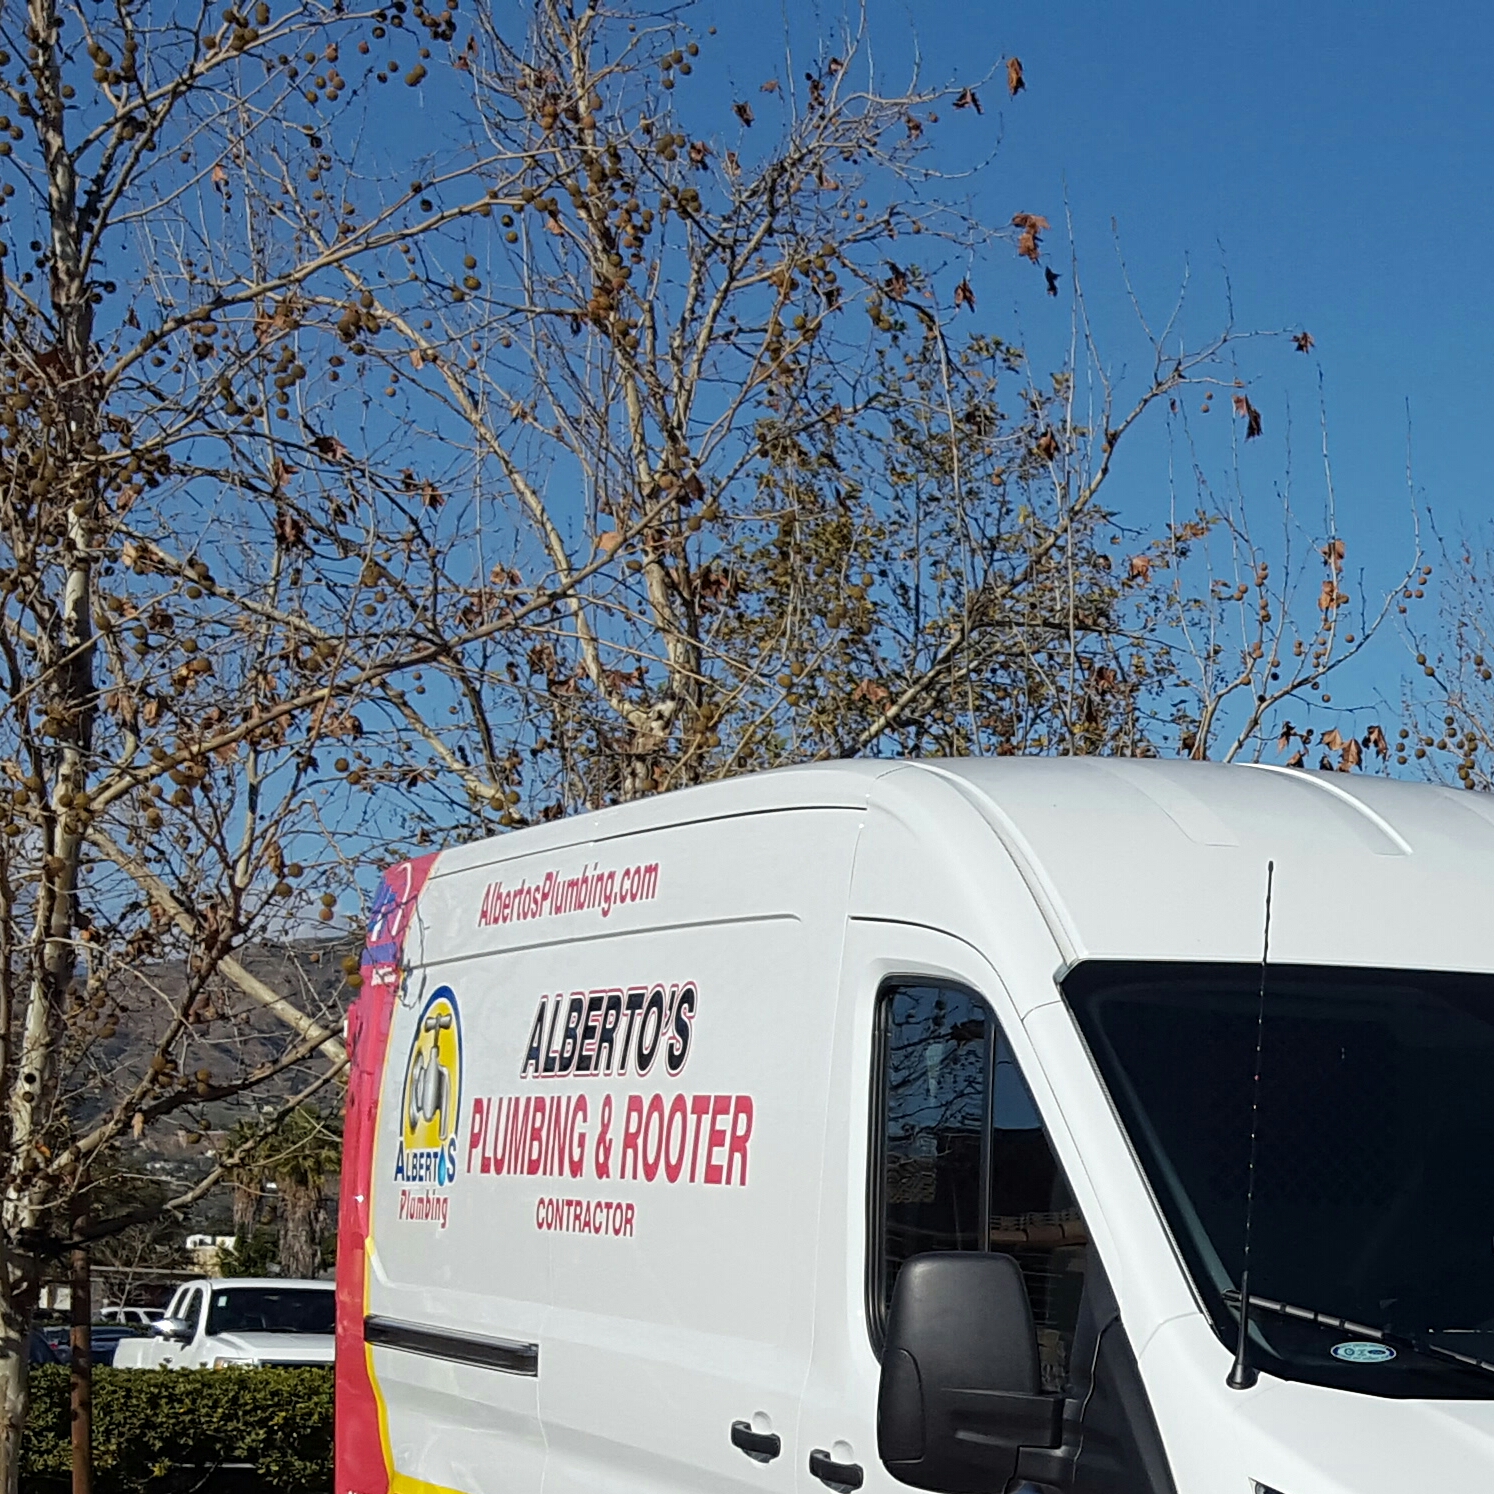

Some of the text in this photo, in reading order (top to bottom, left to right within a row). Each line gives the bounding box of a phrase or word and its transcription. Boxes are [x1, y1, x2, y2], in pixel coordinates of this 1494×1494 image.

[477, 861, 660, 928] AlbertosPlumbing.com
[520, 980, 698, 1079] ALBERTO'S
[466, 1092, 754, 1187] PLUMBING & ROOTER
[398, 1188, 449, 1229] Plumbing
[536, 1196, 636, 1238] CONTRACTOR
